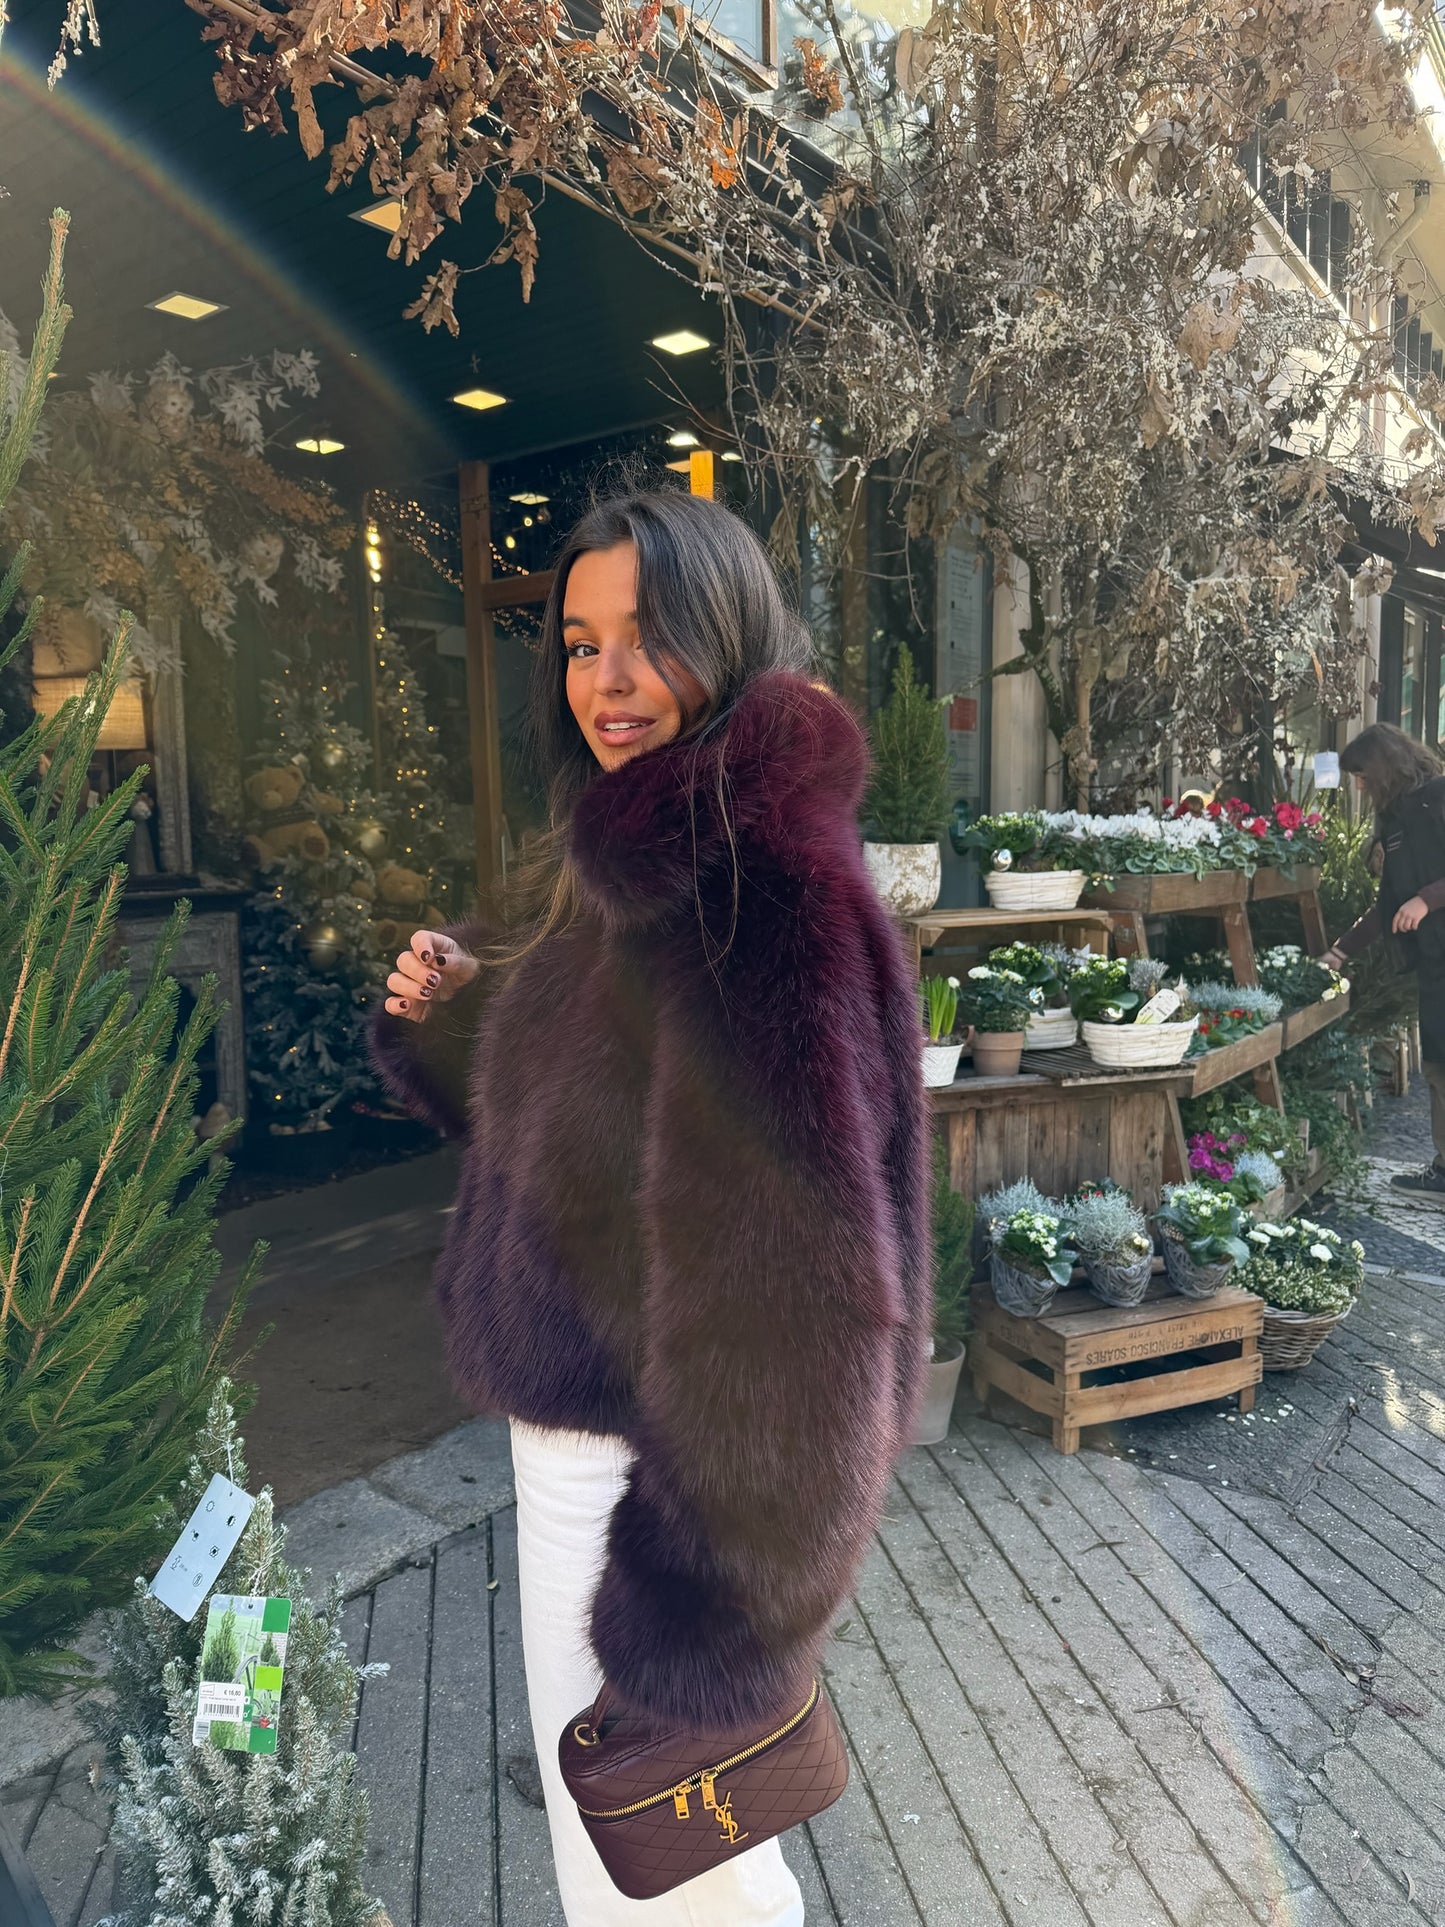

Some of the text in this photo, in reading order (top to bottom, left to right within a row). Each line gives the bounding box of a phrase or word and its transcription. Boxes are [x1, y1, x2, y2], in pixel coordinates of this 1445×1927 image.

[1086, 1346, 1127, 1366] SOARES
[1130, 1336, 1185, 1358] FRANCISCO
[715, 1791, 749, 1844] YSL
